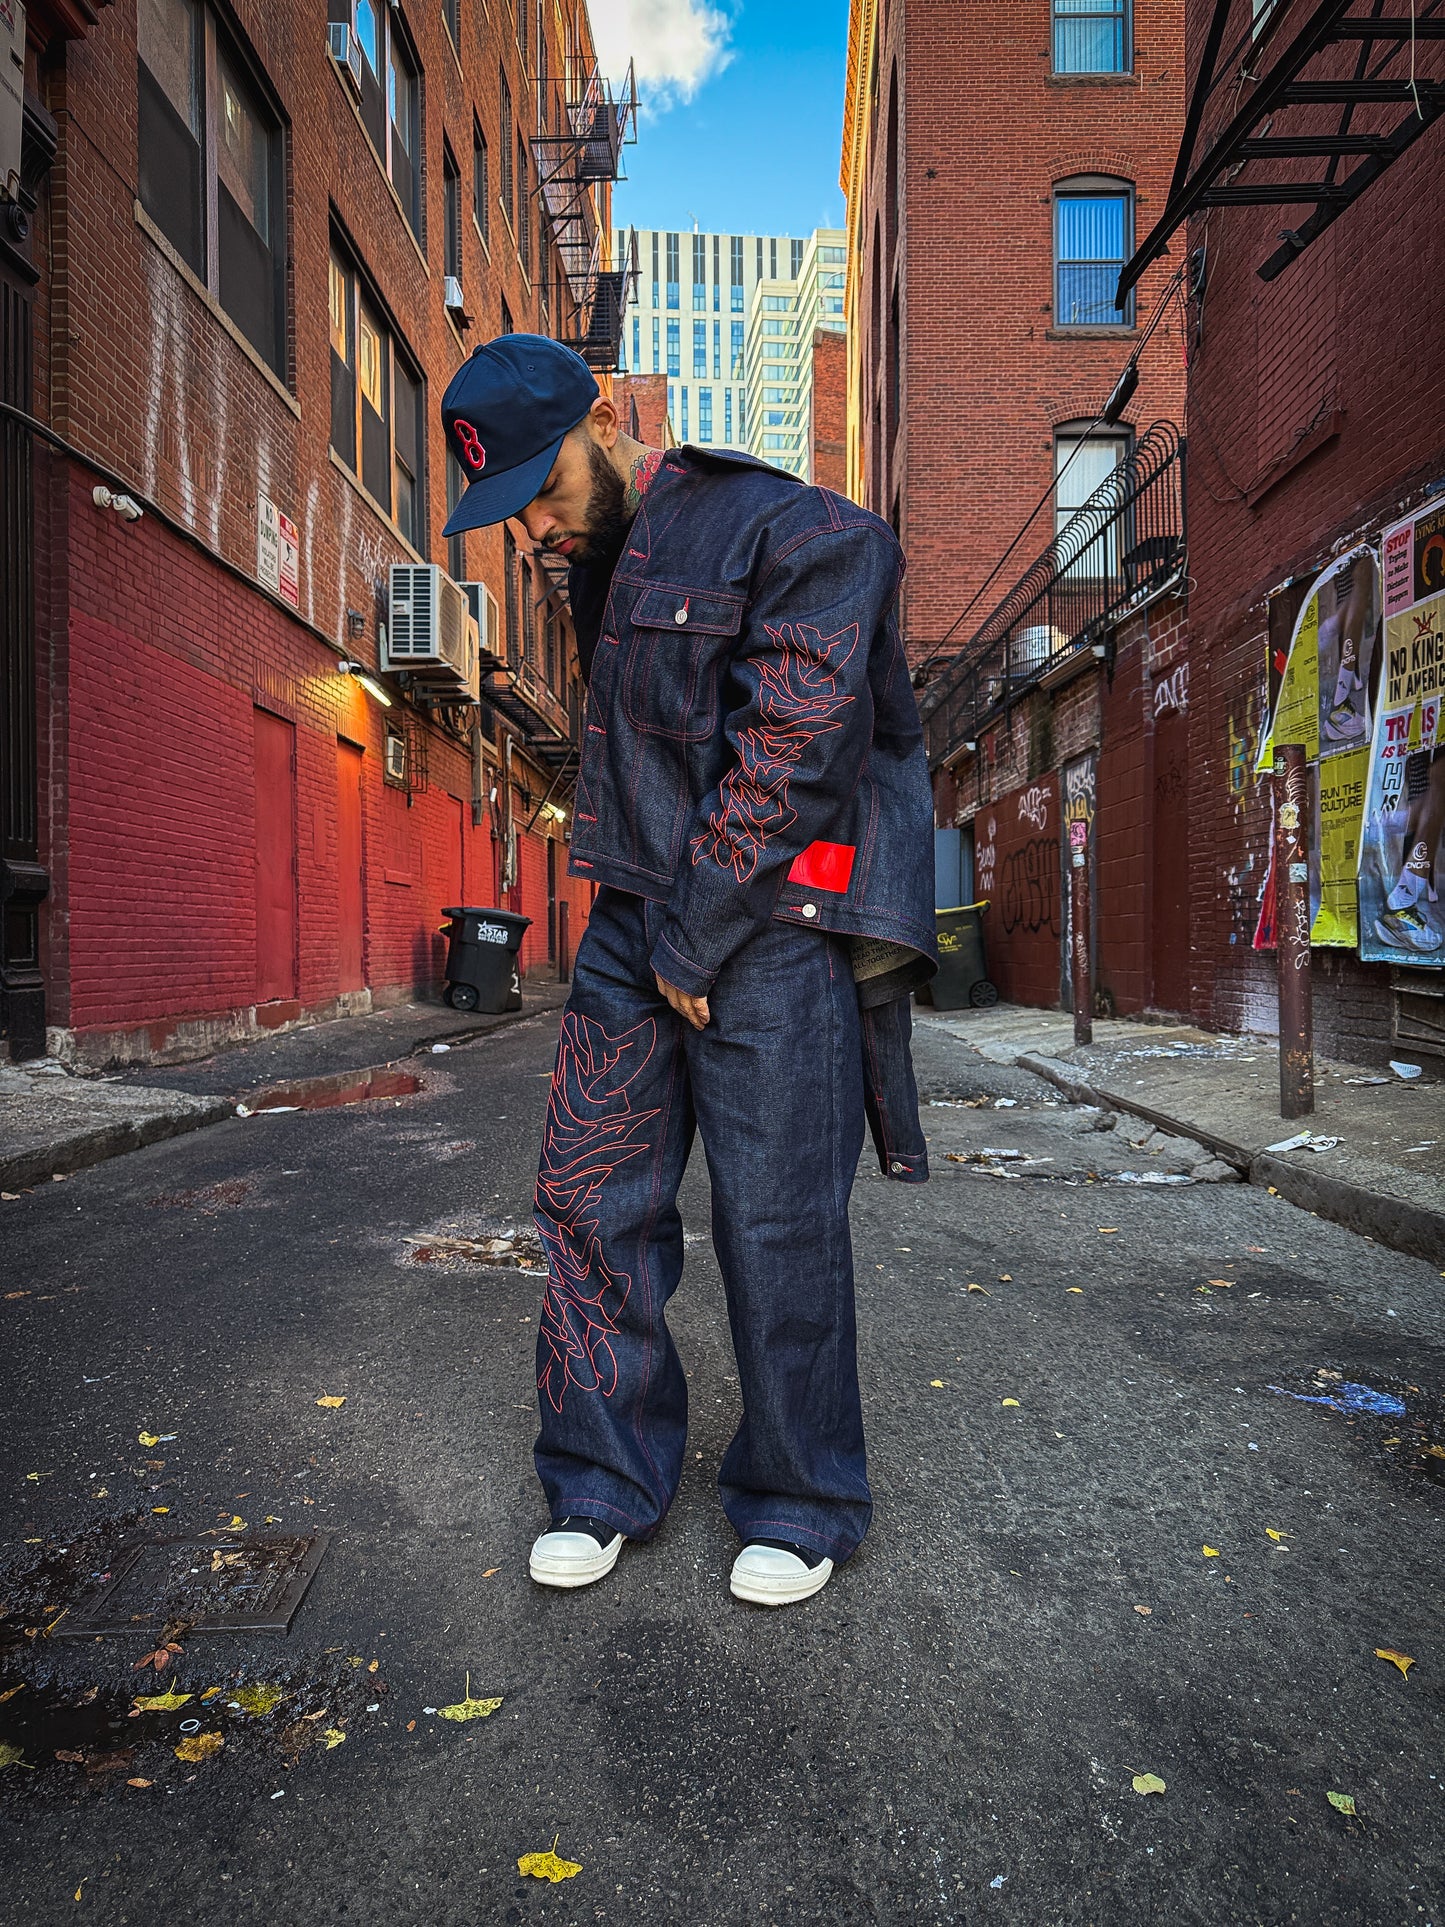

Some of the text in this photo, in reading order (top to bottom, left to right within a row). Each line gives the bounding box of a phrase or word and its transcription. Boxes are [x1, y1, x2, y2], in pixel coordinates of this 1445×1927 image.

[1386, 529, 1411, 554] STOP
[1389, 646, 1407, 680] NO
[1388, 677, 1402, 703] IN
[1380, 745, 1396, 759] IS
[1320, 780, 1363, 801] RUN THE
[1320, 794, 1363, 814] CULTURE
